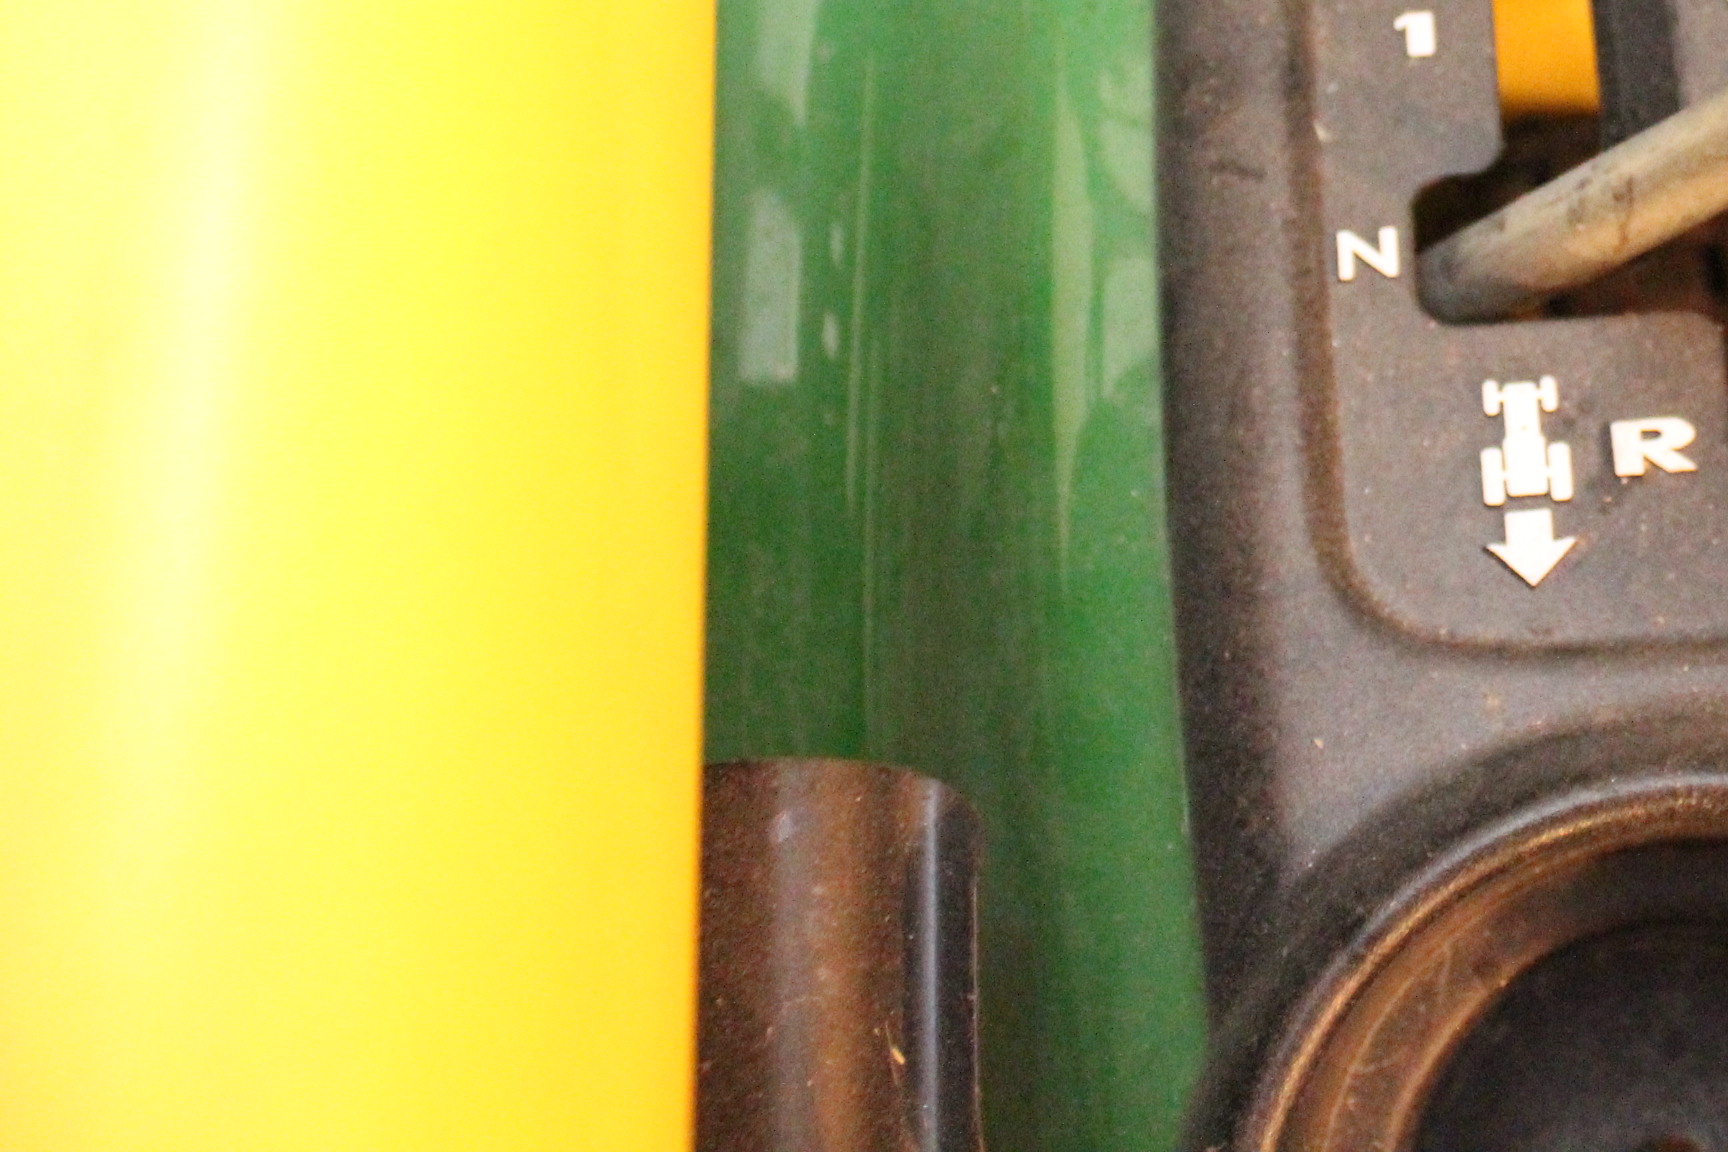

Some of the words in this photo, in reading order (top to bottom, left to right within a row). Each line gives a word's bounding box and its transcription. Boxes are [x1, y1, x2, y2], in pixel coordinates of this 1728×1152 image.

[1393, 10, 1437, 58] 1
[1335, 225, 1401, 281] N
[1609, 415, 1699, 478] R
